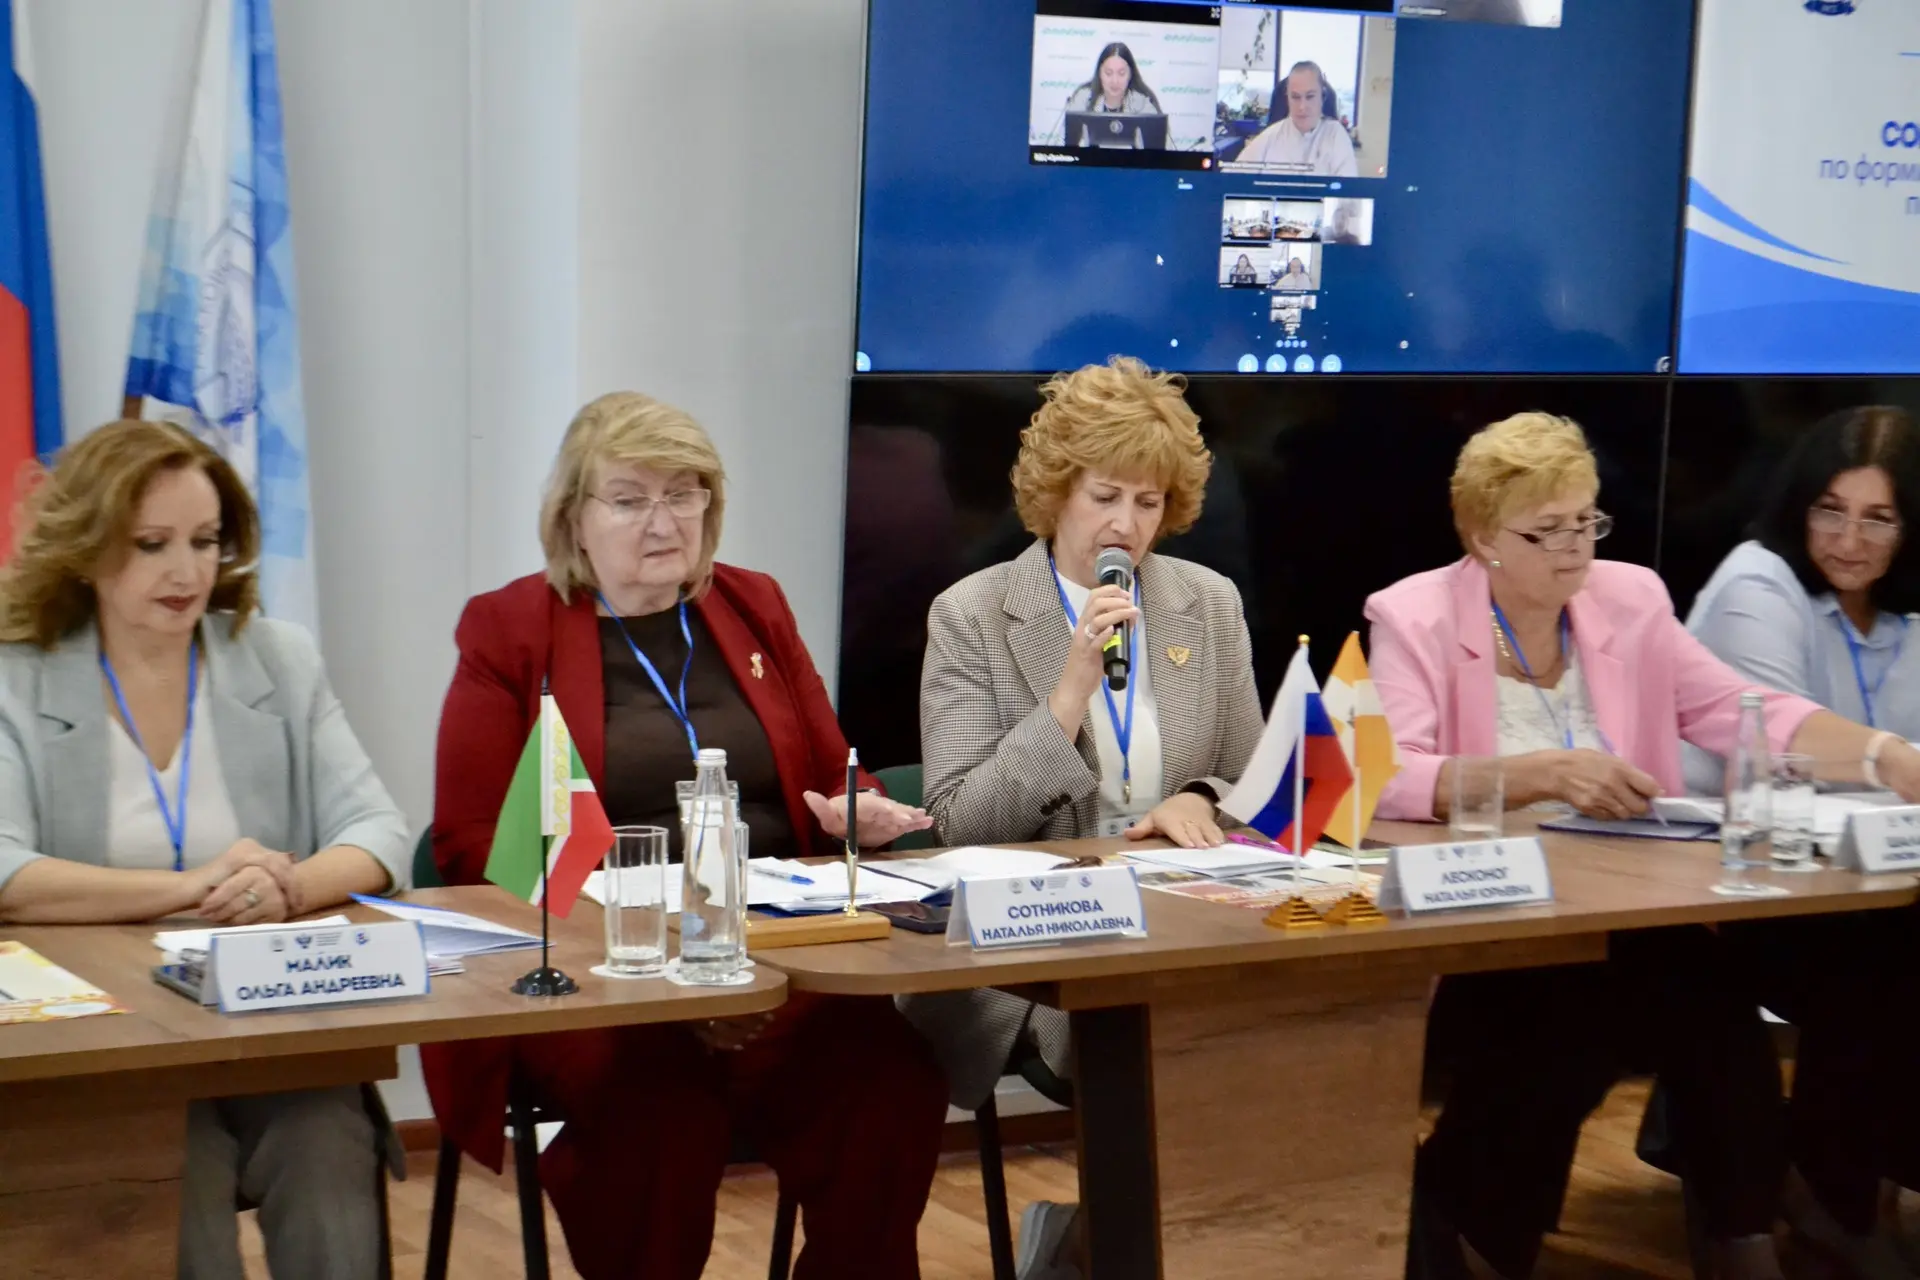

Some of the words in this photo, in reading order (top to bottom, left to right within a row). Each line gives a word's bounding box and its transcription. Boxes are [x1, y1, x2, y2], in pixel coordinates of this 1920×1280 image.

[1882, 121, 1920, 148] СО
[1820, 160, 1849, 180] по
[1008, 900, 1103, 919] СОТНИКОВА
[982, 924, 1044, 940] НАТАЛЬЯ
[1046, 916, 1135, 935] НИКОЛАЕВНА
[286, 954, 352, 973] МАЛИК
[237, 982, 296, 1001] ОЛЬГА
[301, 973, 405, 995] АНДРЕЕВНА
